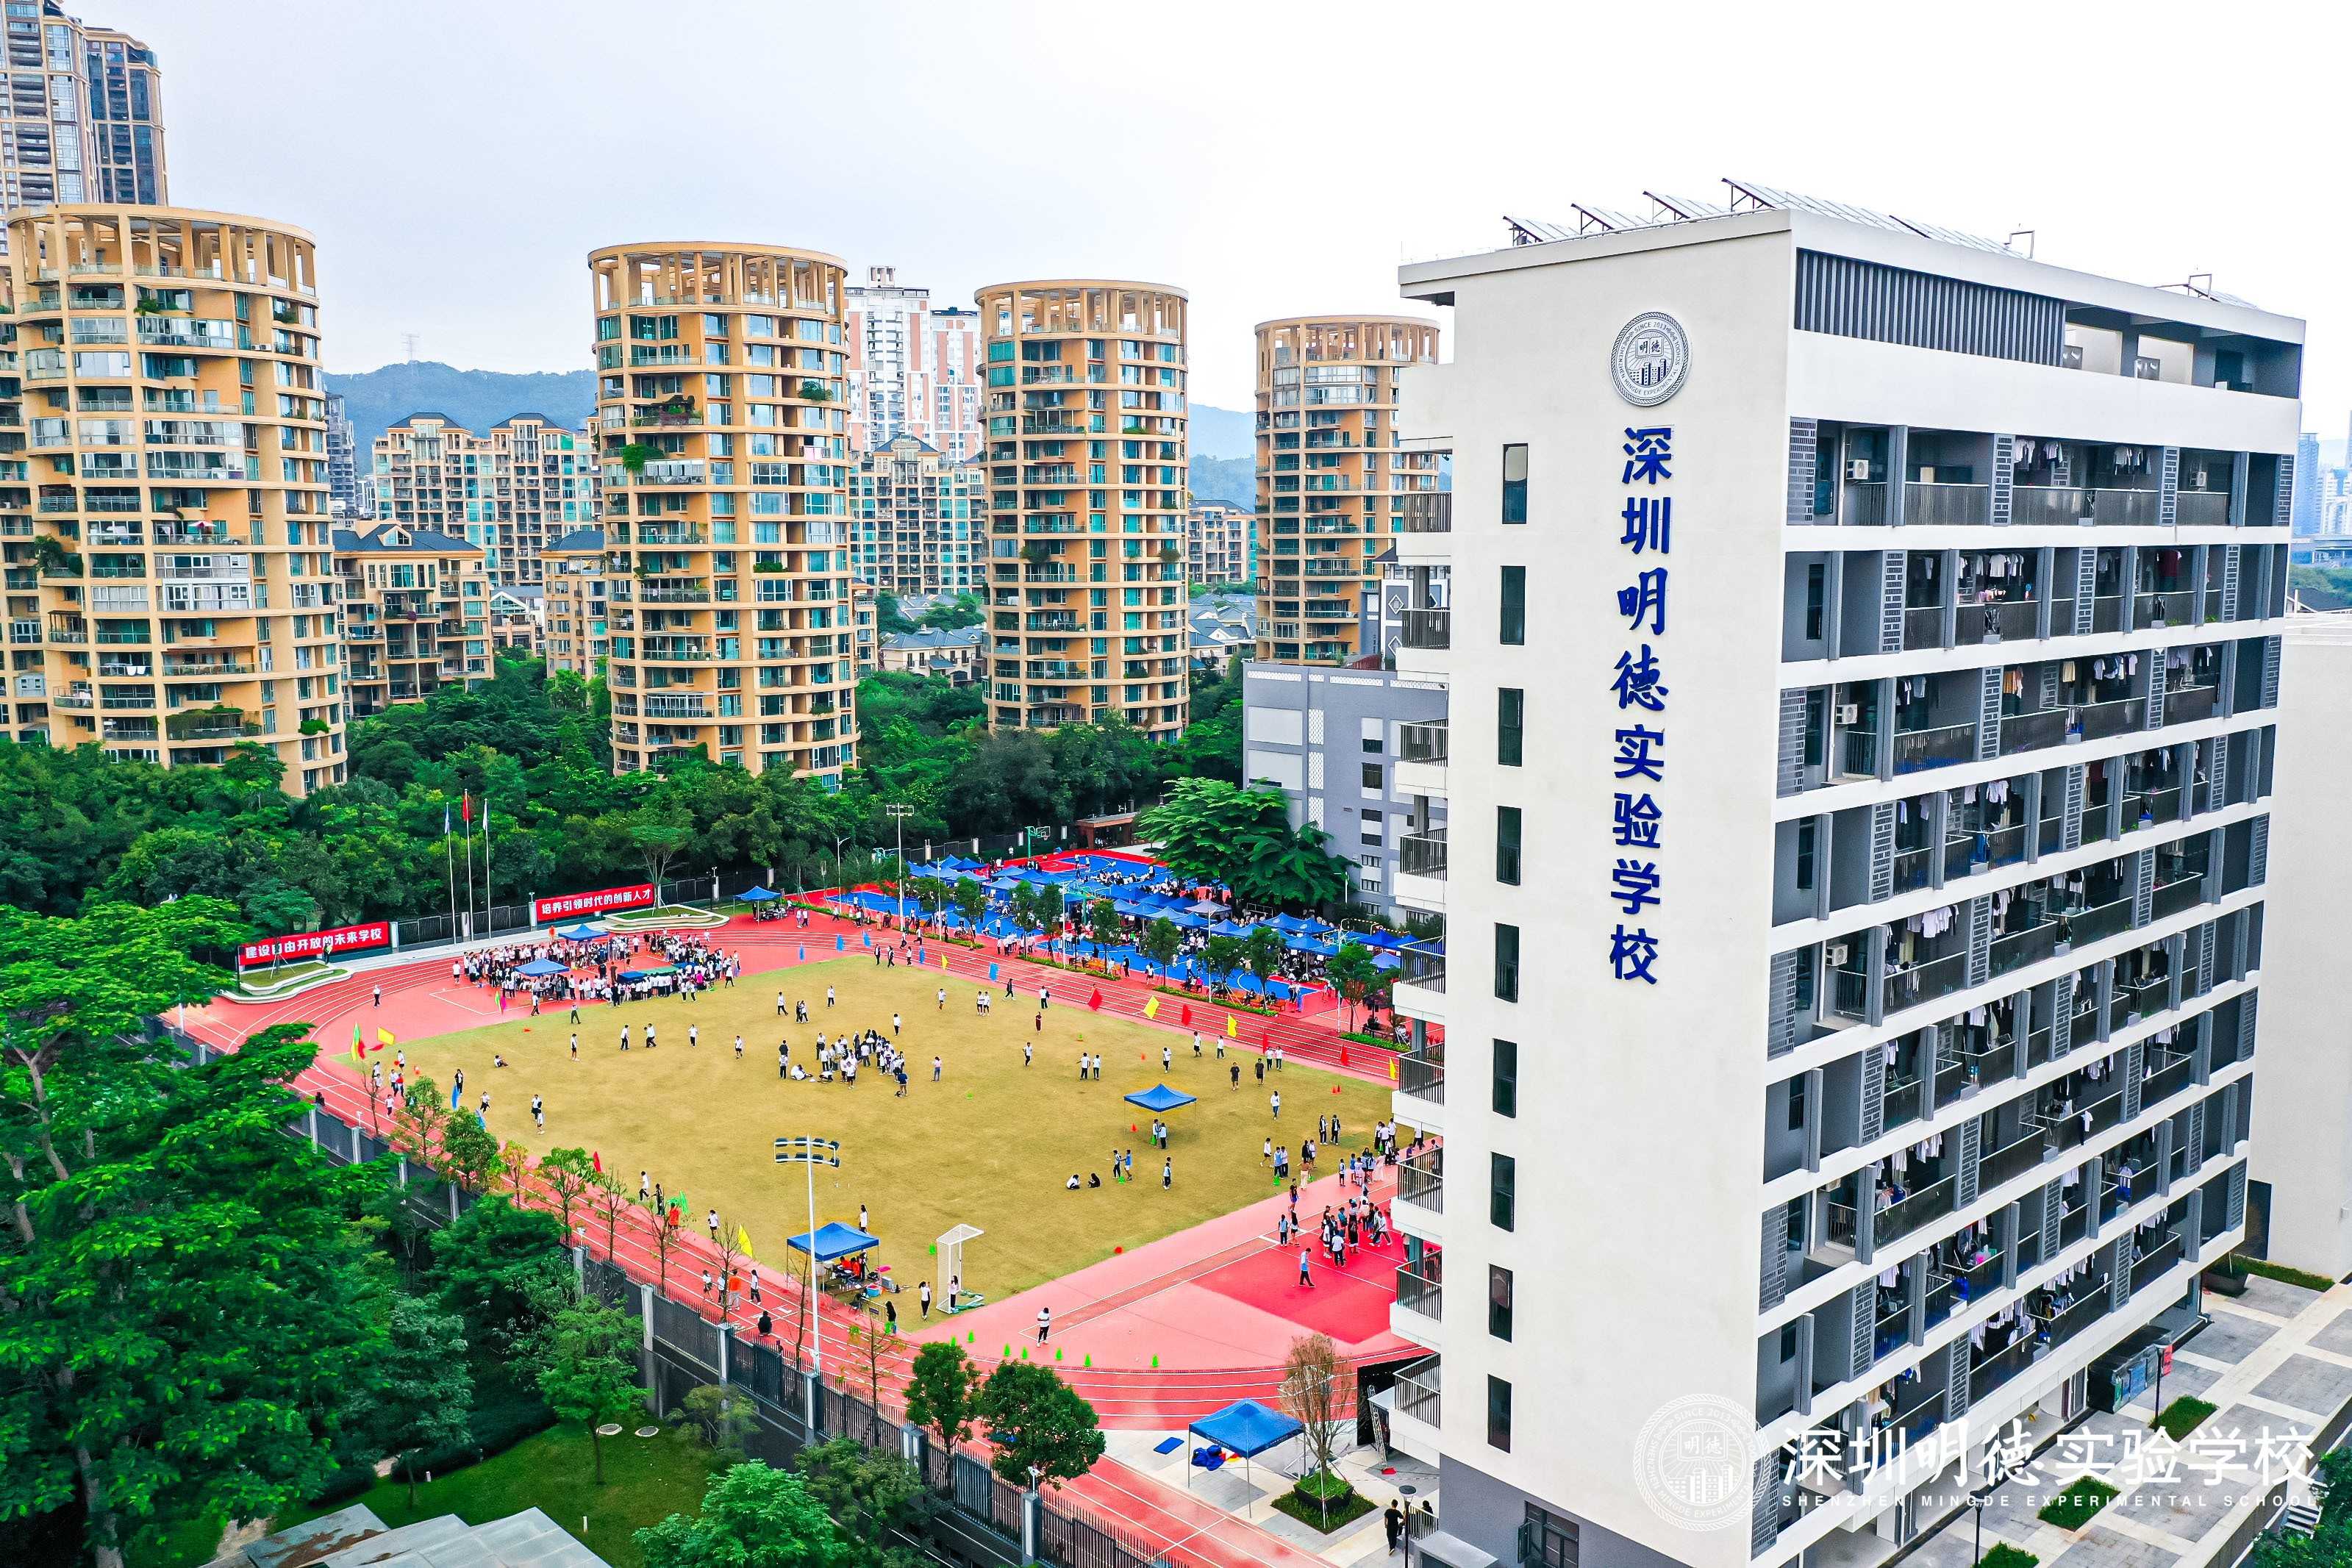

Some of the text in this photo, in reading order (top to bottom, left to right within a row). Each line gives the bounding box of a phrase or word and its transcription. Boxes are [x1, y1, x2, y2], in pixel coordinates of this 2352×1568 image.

[1634, 321, 1667, 332] SINCE 2013
[1640, 340, 1661, 354] 明德
[1618, 346, 1626, 379] SHENZHEN
[1625, 379, 1642, 395] MINGDE
[1609, 427, 1672, 984] 深圳明德实验学校
[541, 888, 651, 914] 培养引领时代的创新人才
